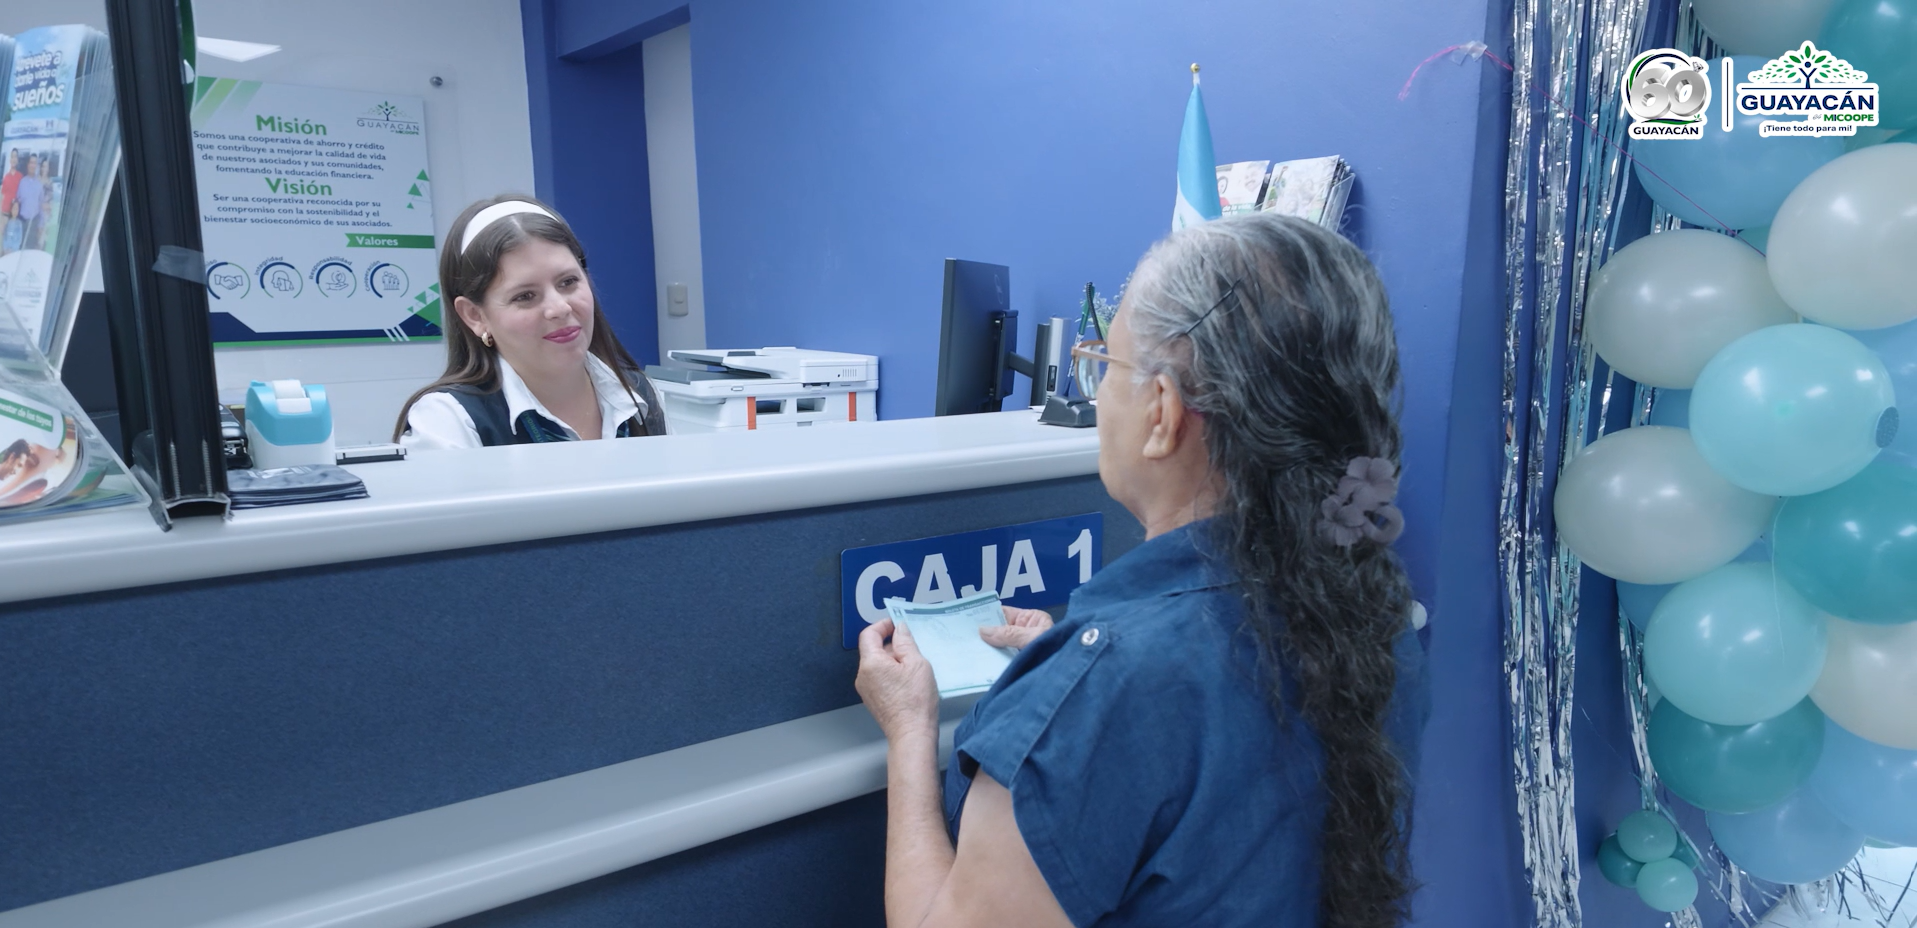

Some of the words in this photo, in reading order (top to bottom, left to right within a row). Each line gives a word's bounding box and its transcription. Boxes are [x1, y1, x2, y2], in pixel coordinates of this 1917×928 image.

[12, 81, 65, 111] sueños
[256, 114, 327, 136] Misión
[193, 130, 226, 140] Somos
[248, 135, 301, 145] cooperativa
[303, 138, 314, 146] de
[316, 139, 346, 148] ahorro
[347, 142, 353, 150] y
[355, 141, 385, 150] crédito
[197, 143, 214, 151] que
[217, 144, 267, 155] contribuye
[277, 147, 313, 157] mejorar
[315, 149, 323, 157] la
[325, 150, 355, 159] calidad
[357, 152, 368, 160] de
[369, 152, 386, 160] vida
[202, 153, 214, 161] de
[216, 155, 256, 163] nuestros
[259, 156, 301, 166] asociados
[326, 161, 384, 171] comunidades,
[216, 164, 272, 175] fomentando
[274, 167, 283, 175] la
[284, 168, 329, 178] educación
[330, 170, 374, 180] financiera.
[264, 177, 333, 196] Visión
[213, 193, 230, 201] Ser
[251, 196, 304, 205] cooperativa
[306, 198, 353, 207] reconocida
[217, 205, 275, 214] compromiso
[295, 207, 304, 215] la
[306, 208, 363, 217] sostenibilidad
[365, 210, 371, 218] y
[204, 215, 248, 223] bienestar
[250, 216, 322, 226] socioeconómico
[323, 218, 334, 226] de
[351, 219, 393, 228] asociados.
[355, 236, 399, 246] Valores
[254, 256, 283, 276] Integridad
[308, 256, 353, 280] Responsabilidad
[855, 539, 1046, 624] CAJA
[1068, 529, 1093, 584] 1
